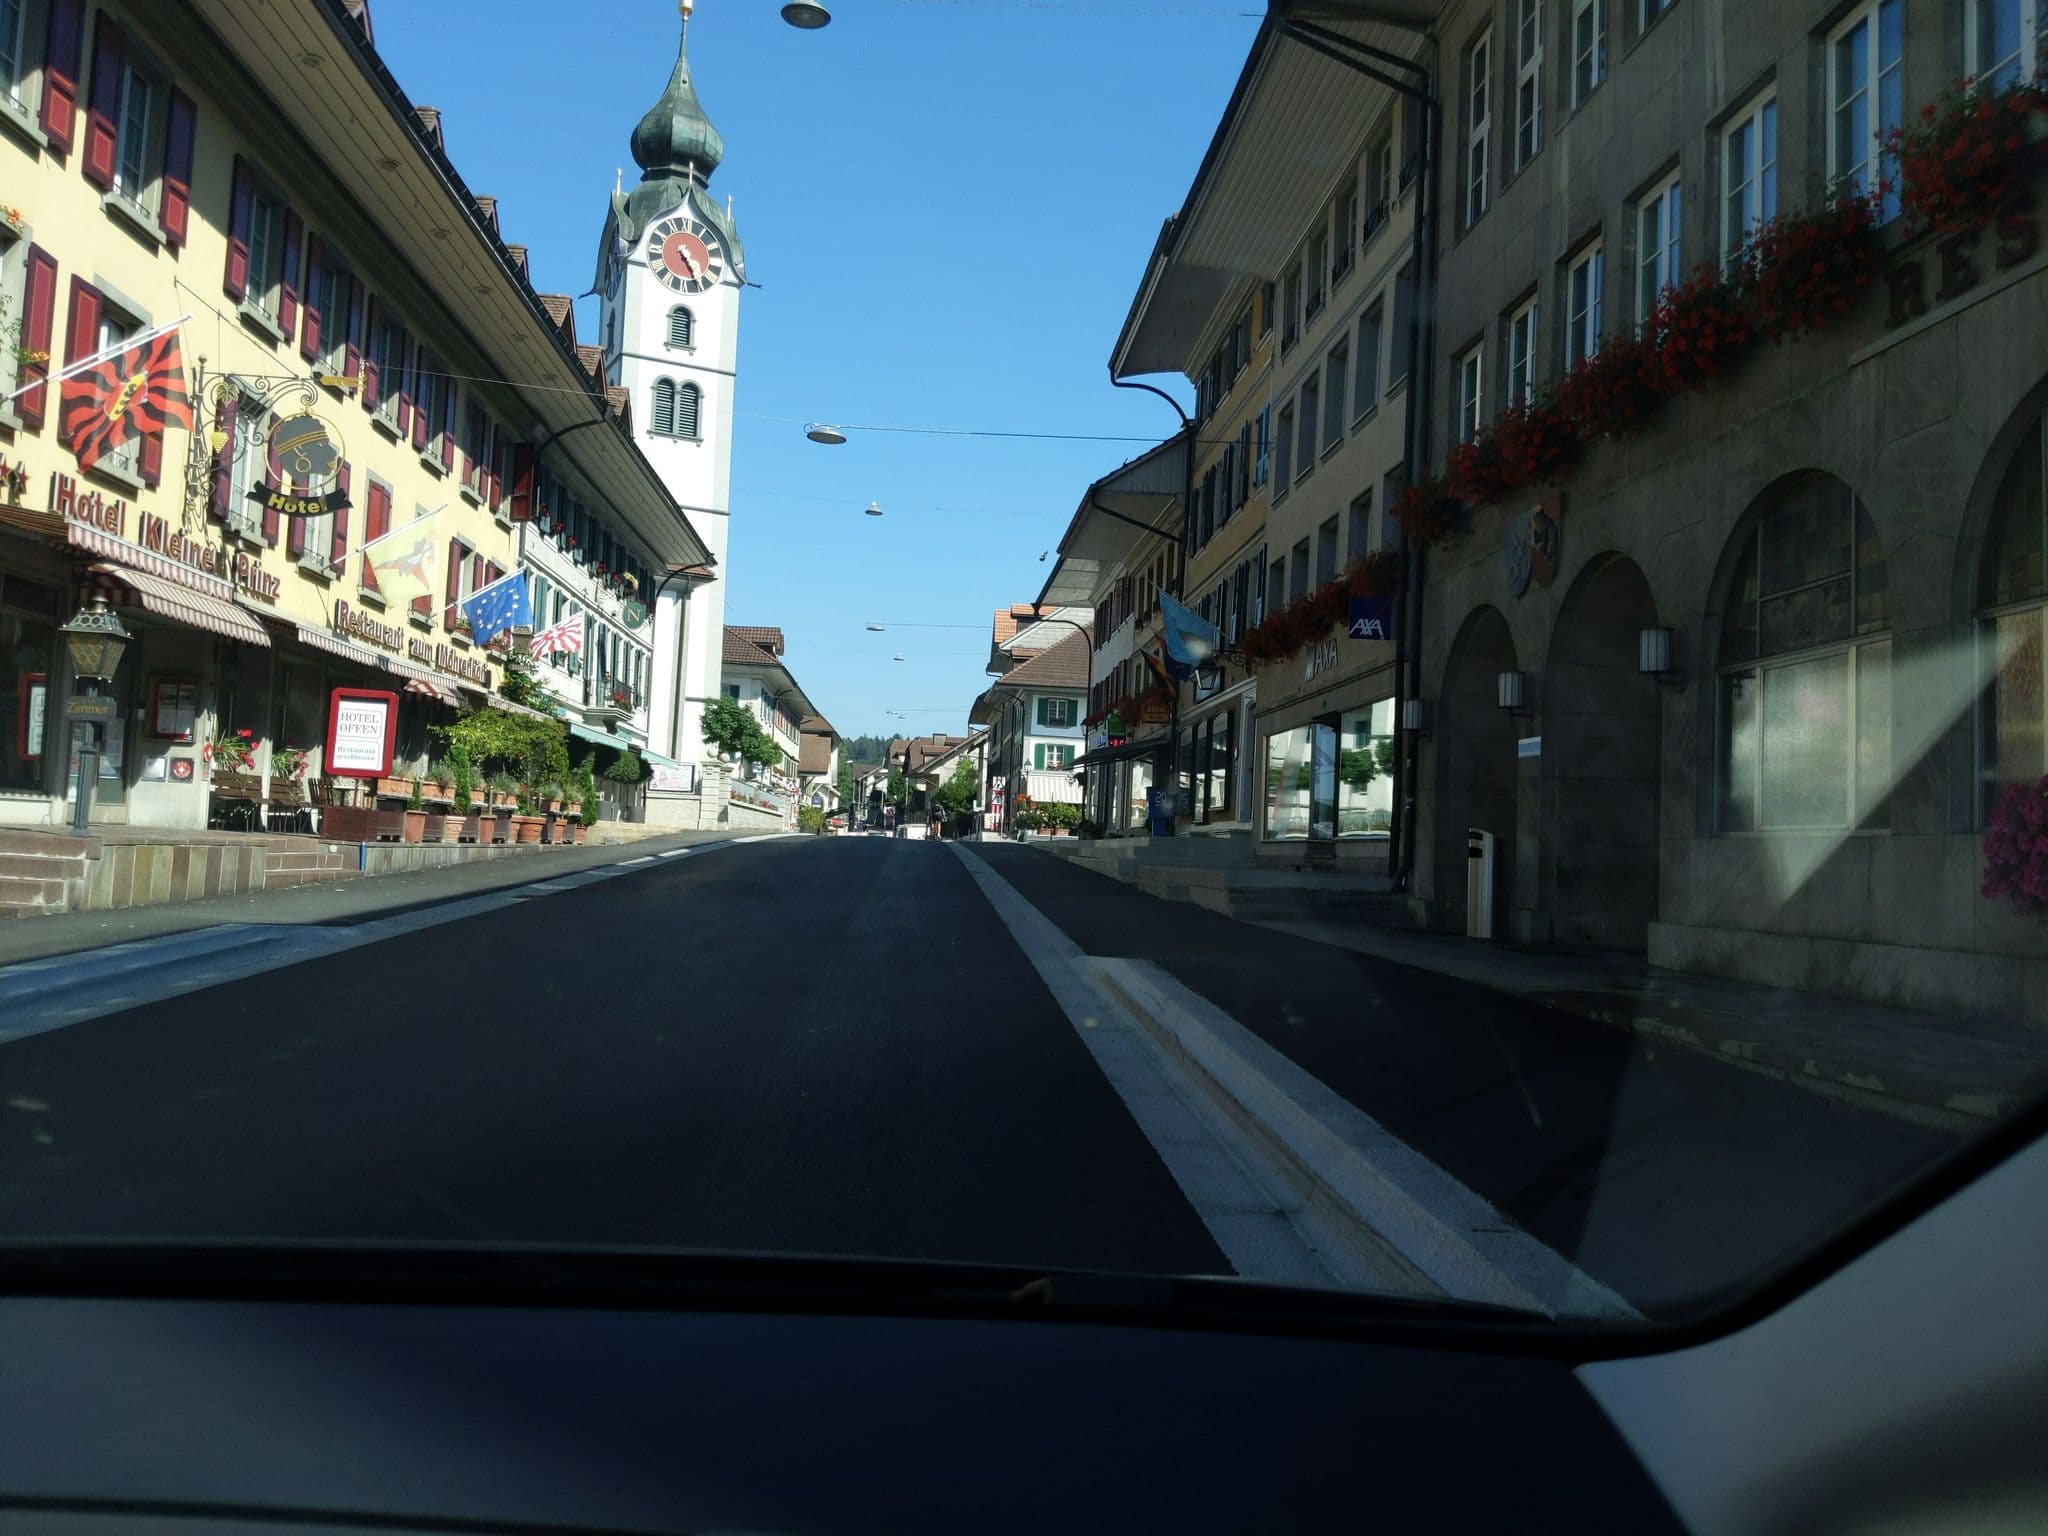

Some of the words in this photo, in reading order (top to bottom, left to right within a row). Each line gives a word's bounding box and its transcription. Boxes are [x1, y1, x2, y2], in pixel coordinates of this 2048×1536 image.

[267, 493, 328, 514] Hotel
[52, 471, 126, 537] Hotel
[236, 551, 281, 598] Prinz
[625, 608, 641, 623] N
[338, 599, 405, 650] Restaurant
[411, 637, 433, 662] zum
[1348, 618, 1384, 636] AXA
[1314, 639, 1338, 674] AXA
[66, 702, 112, 715] Zimmer
[341, 712, 379, 724] HOTEL
[340, 723, 378, 734] OFFEN
